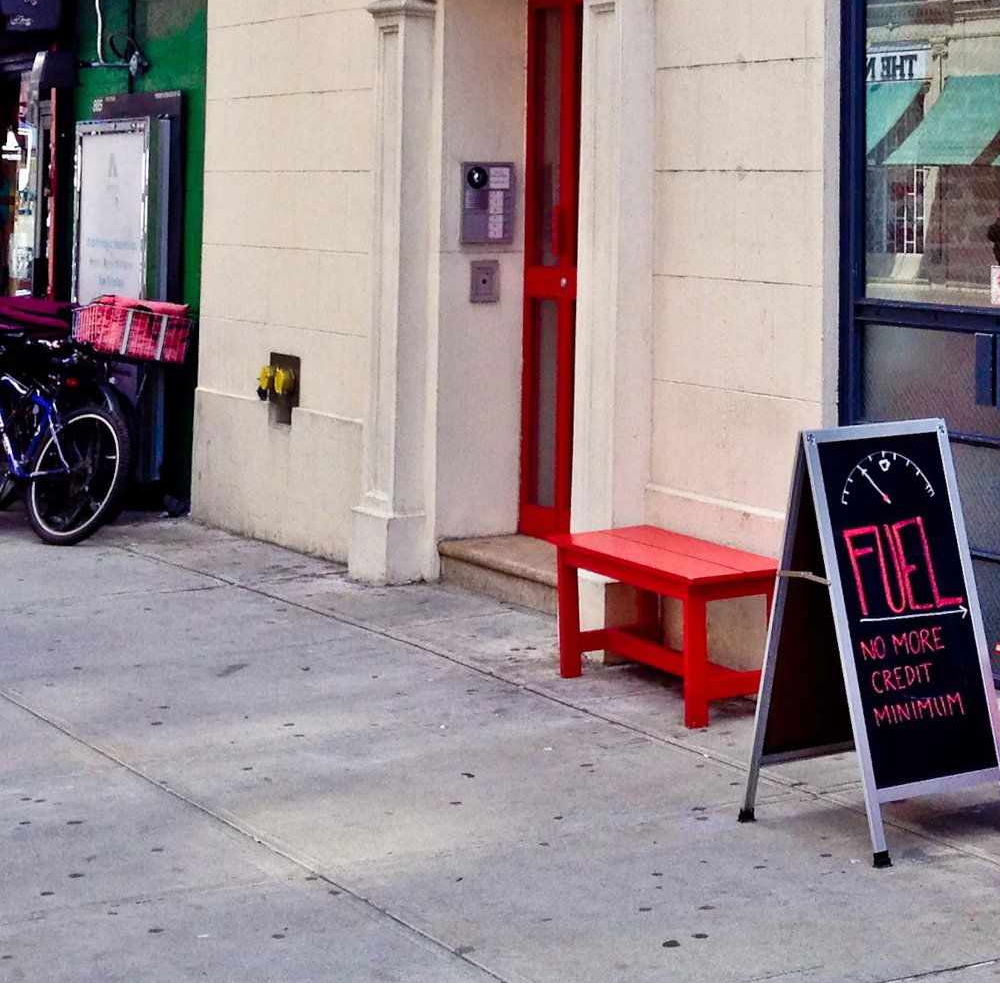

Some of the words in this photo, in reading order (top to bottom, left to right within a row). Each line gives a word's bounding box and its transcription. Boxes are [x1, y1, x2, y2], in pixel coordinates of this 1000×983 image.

[842, 516, 964, 616] FUEL
[860, 636, 886, 662] NO
[891, 625, 945, 655] MORE
[871, 662, 932, 695] CREDIT
[873, 692, 965, 728] MINIMUM
